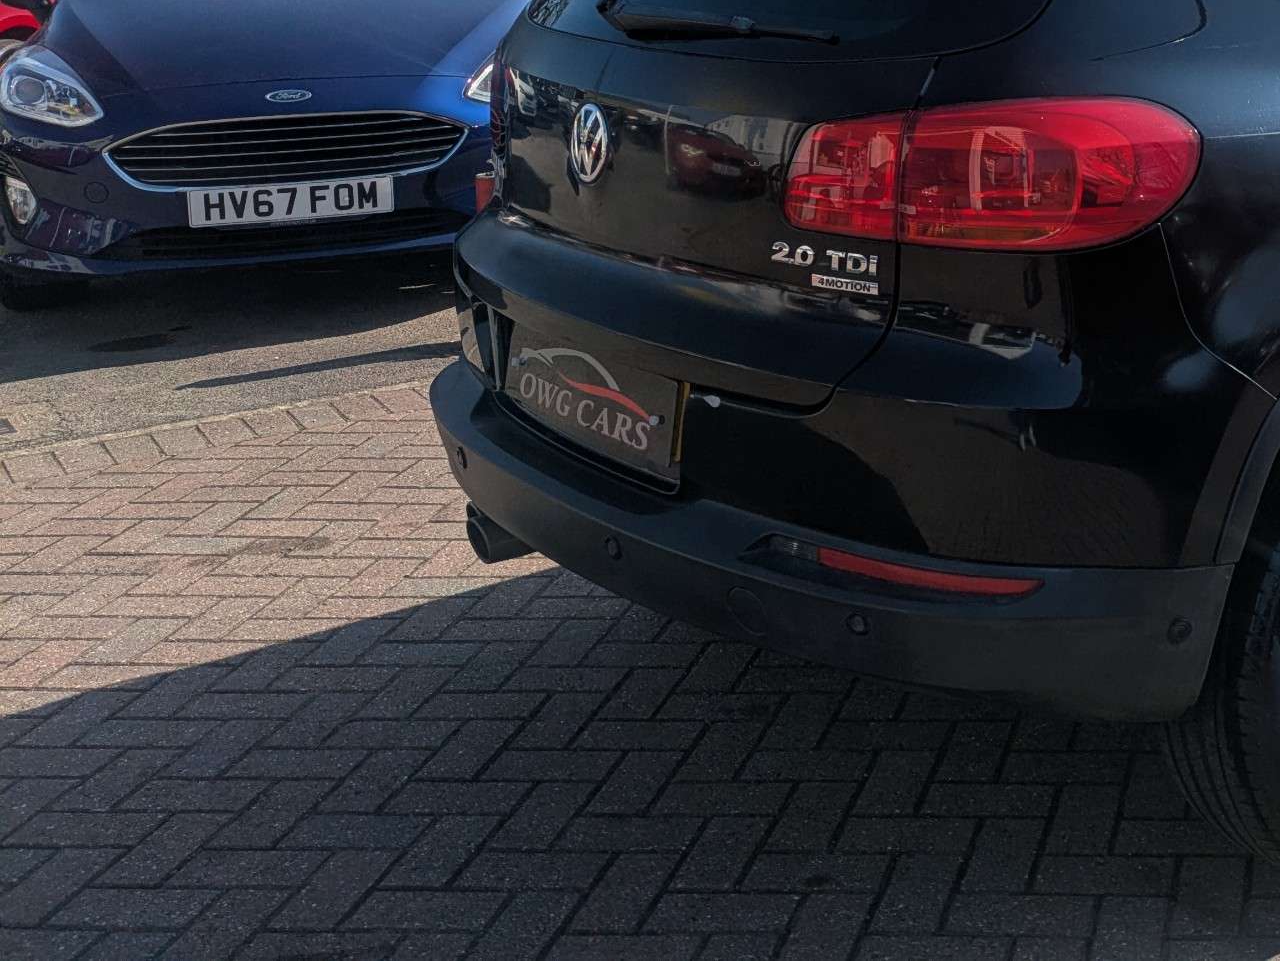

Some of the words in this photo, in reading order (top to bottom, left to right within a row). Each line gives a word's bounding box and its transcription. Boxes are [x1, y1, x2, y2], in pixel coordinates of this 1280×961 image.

[203, 188, 298, 221] HV67
[309, 181, 378, 214] FOM
[771, 241, 815, 267] 2.0
[818, 277, 872, 293] 4MOTION
[519, 373, 572, 417] OWG
[576, 399, 651, 450] CARS
